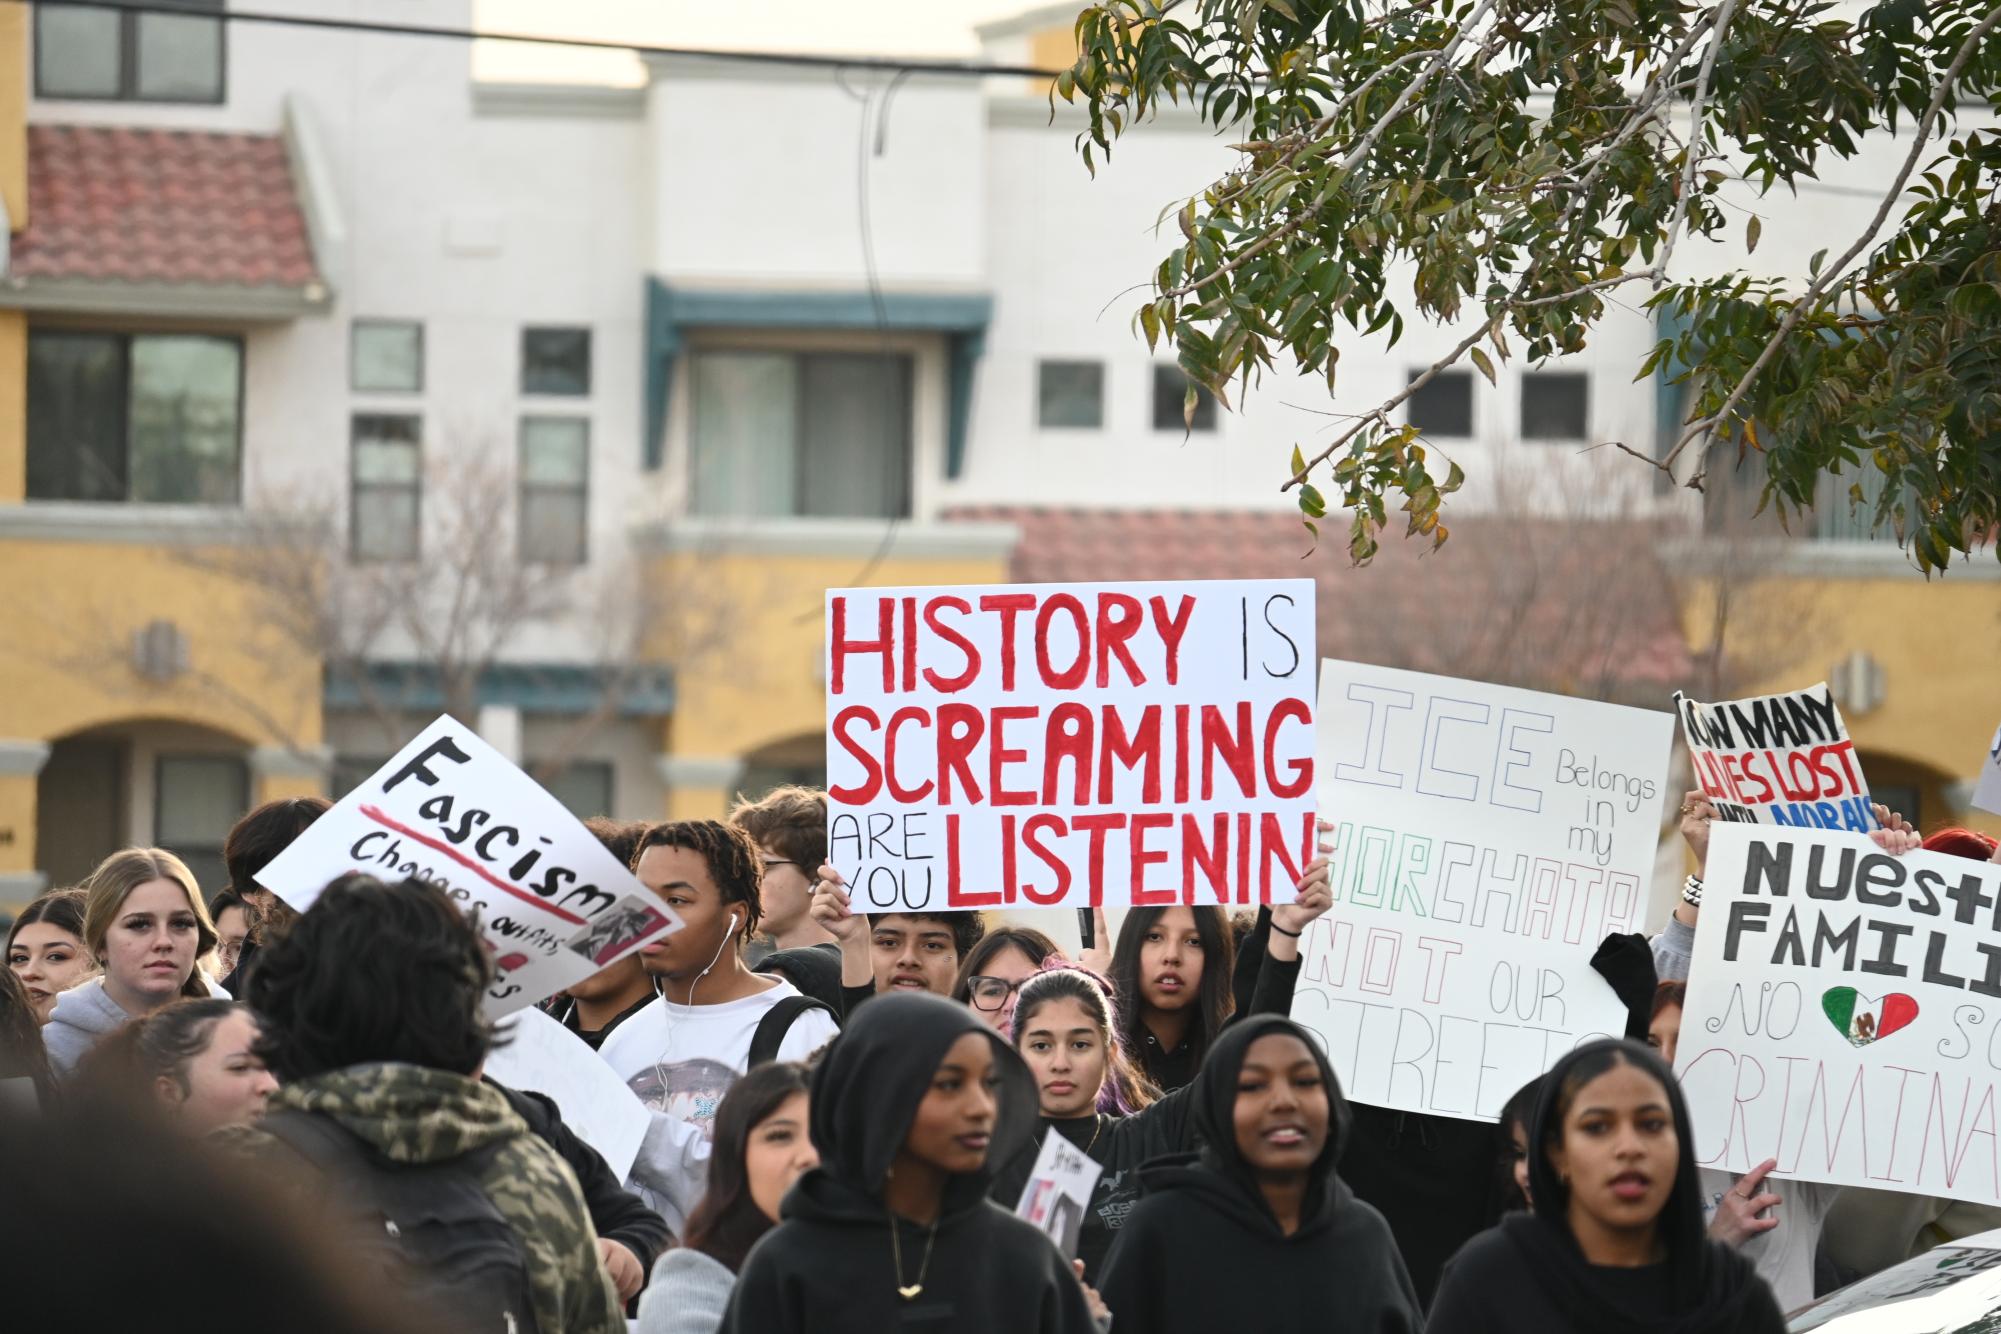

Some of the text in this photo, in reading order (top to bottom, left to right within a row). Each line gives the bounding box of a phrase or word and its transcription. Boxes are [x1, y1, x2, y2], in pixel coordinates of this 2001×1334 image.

[831, 592, 1300, 695] HISTORY IS
[1335, 683, 1555, 813] ICE
[1729, 688, 1840, 749] MANY
[828, 697, 1315, 806] SCREAMING
[1556, 748, 1656, 813] Belongs
[1691, 740, 1860, 804] LIVES LOST
[382, 736, 616, 919] Fascism
[831, 812, 934, 864] ARE
[1586, 795, 1614, 827] in
[947, 812, 1315, 907] LISTENIN
[1568, 827, 1612, 865] my
[1304, 917, 1567, 1026] NOT OUR
[1706, 981, 1802, 1041] NO
